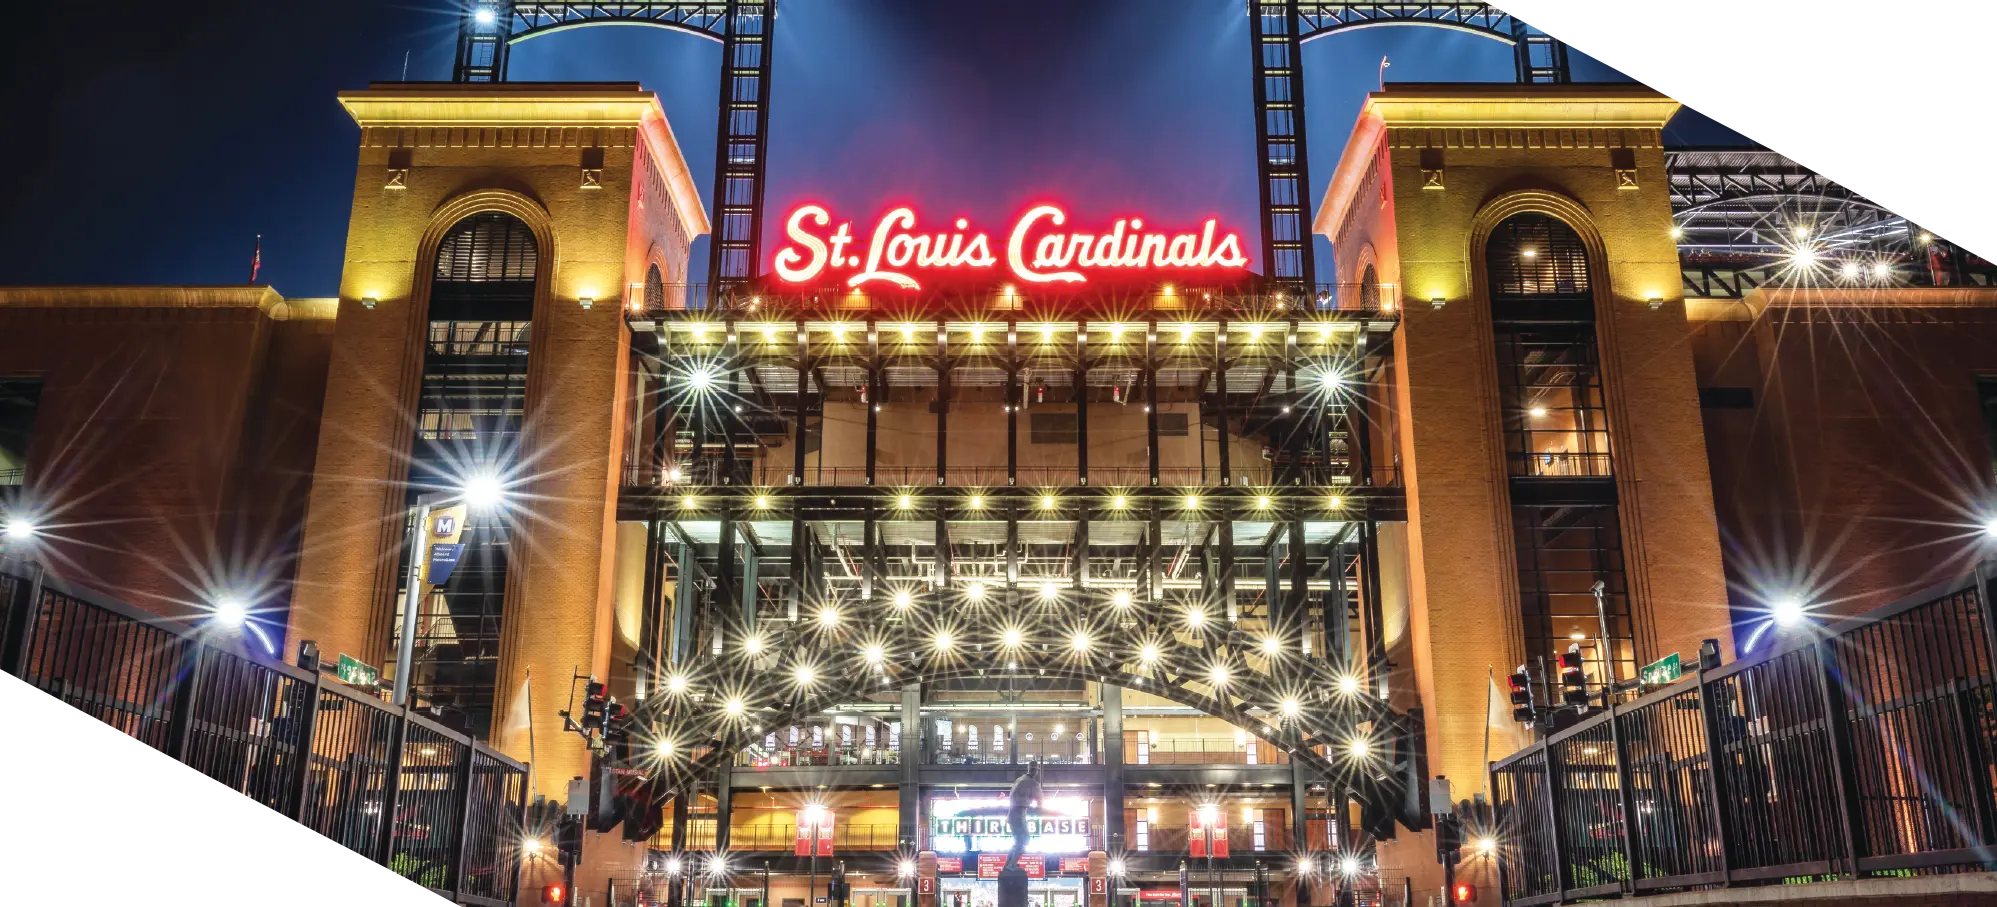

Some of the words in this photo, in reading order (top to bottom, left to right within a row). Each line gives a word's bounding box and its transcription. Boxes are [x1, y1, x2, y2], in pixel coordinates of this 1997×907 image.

[775, 205, 859, 282] St.
[847, 207, 996, 290] Louis
[1008, 205, 1248, 282] Cardinals
[437, 518, 452, 533] M
[1029, 820, 1087, 834] BASE
[923, 879, 929, 892] 3
[1095, 879, 1102, 892] 3
